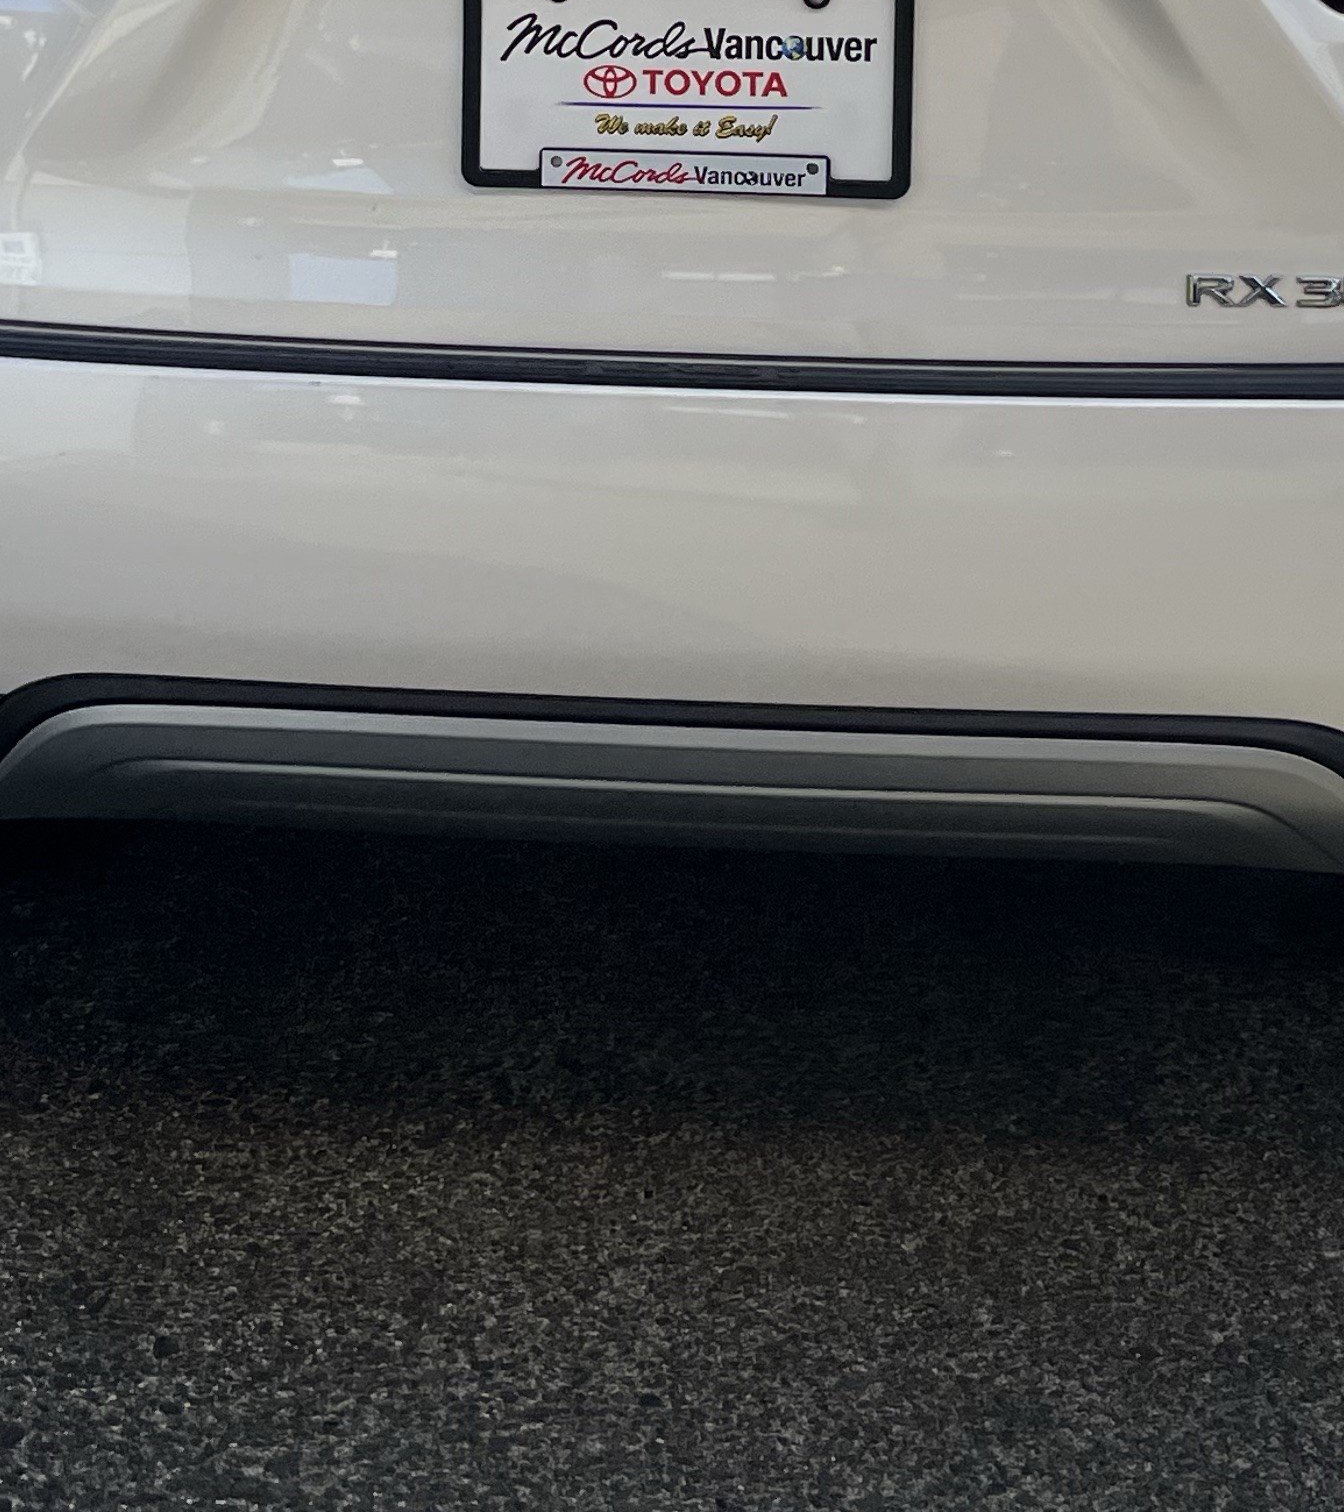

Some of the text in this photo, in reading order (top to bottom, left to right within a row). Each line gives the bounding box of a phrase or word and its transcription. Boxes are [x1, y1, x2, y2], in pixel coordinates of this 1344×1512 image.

[500, 13, 877, 62] McCords Vancouver
[642, 69, 788, 97] TOYOTA
[595, 114, 778, 143] We make it Easy!
[561, 156, 694, 184] McCords
[1185, 273, 1287, 307] RX
